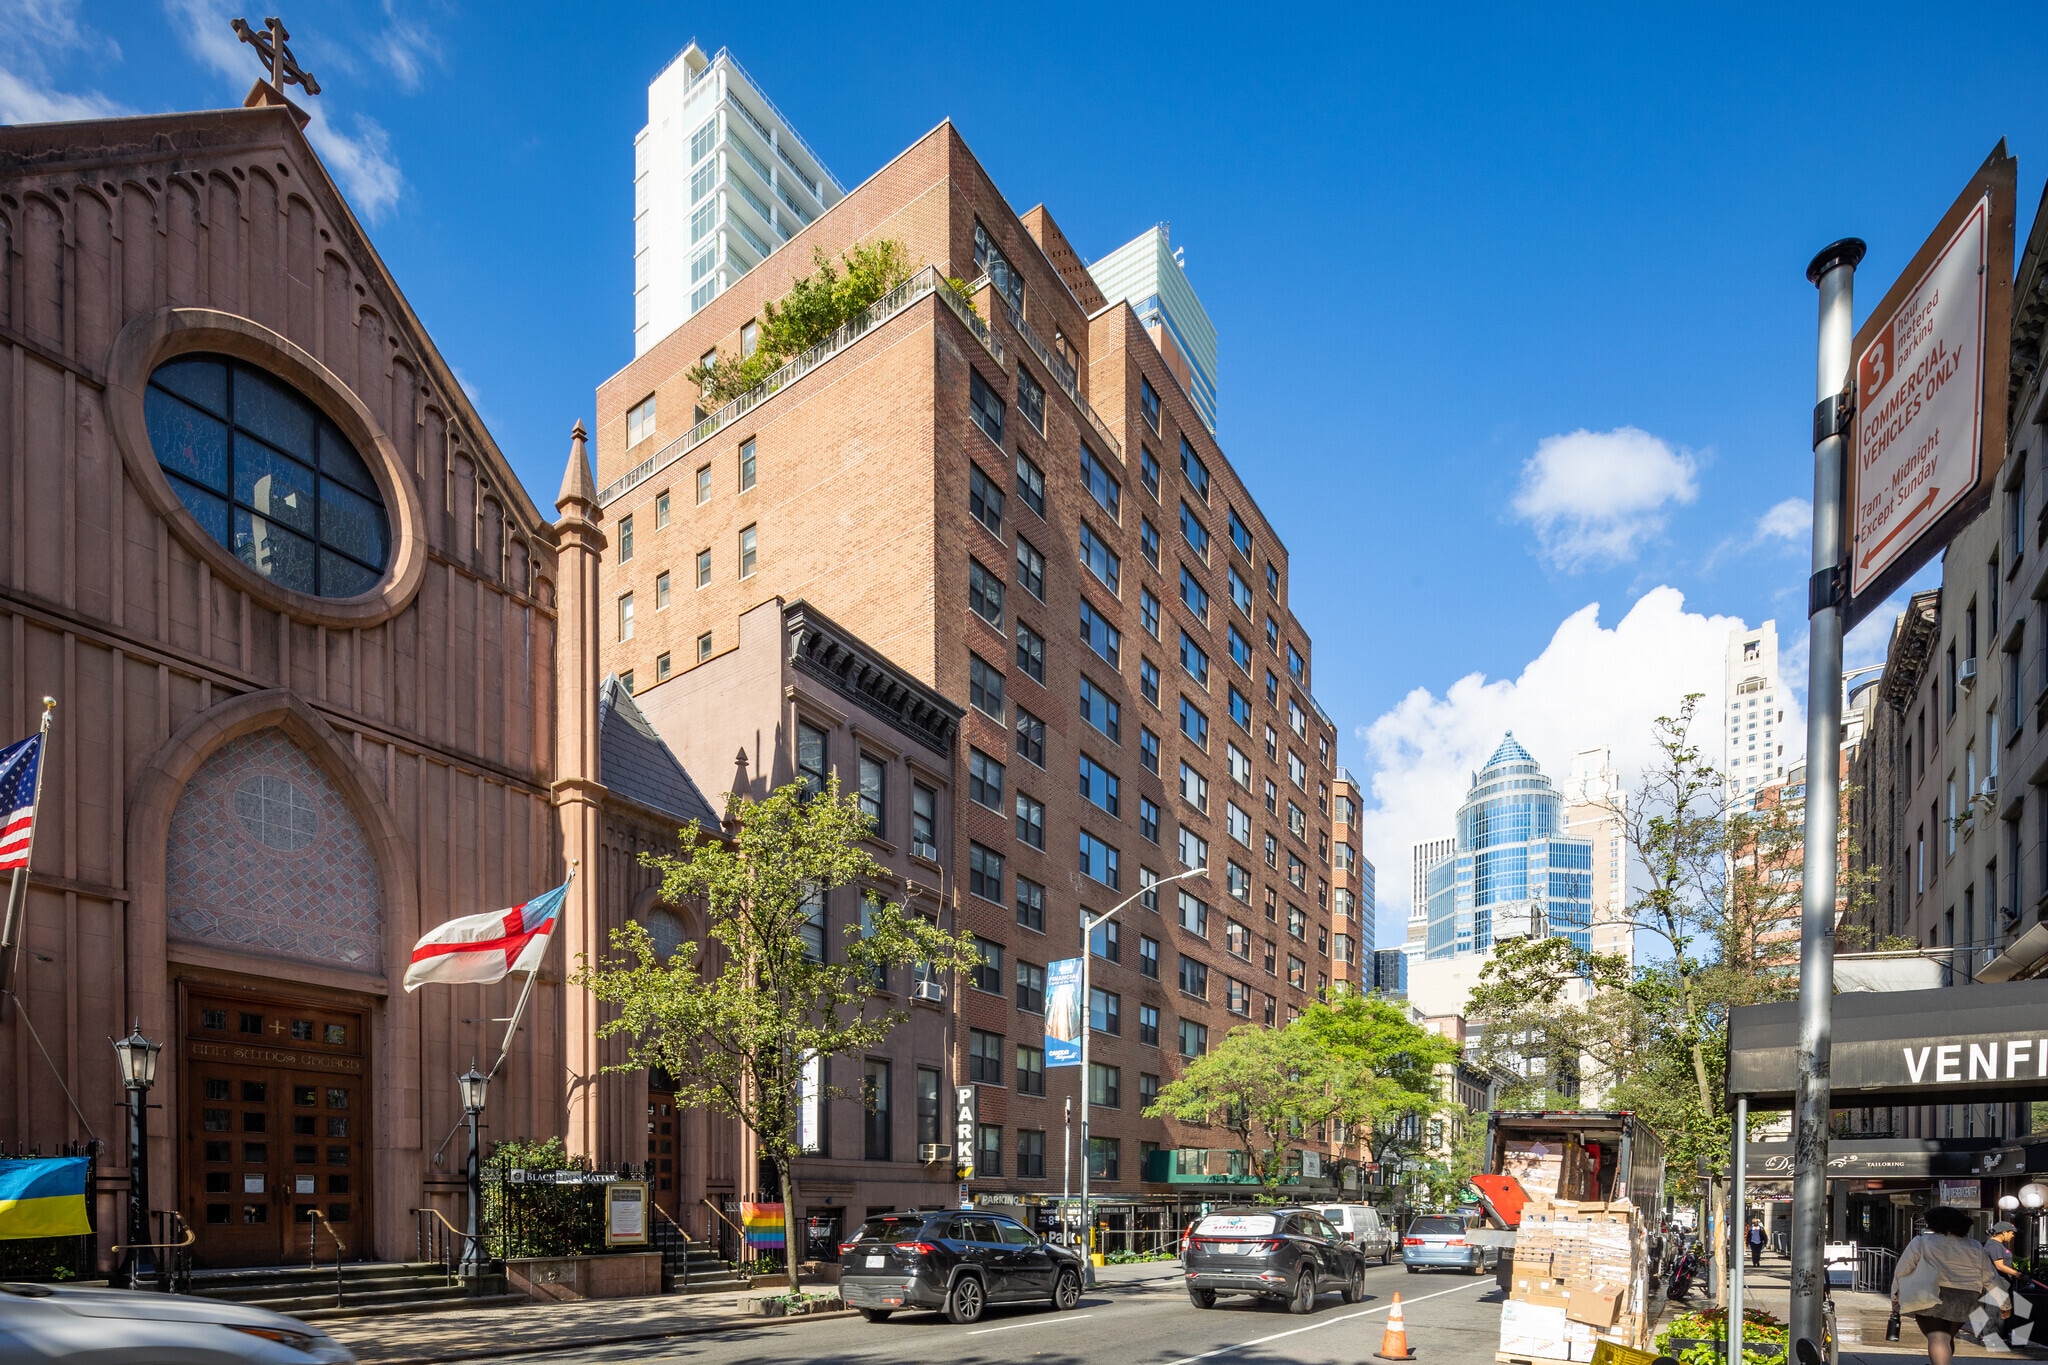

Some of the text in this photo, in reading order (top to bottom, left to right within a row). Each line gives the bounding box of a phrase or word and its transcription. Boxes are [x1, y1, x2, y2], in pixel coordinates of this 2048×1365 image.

[1897, 297, 1920, 333] hour
[1897, 288, 1939, 351] metered
[1897, 318, 1934, 373] parking
[1863, 338, 1947, 447] COMMERCIAL
[1867, 342, 1886, 396] 3
[1863, 344, 1963, 472] VEHICLES ONLY
[1861, 492, 1882, 523] 7am
[1891, 426, 1940, 492] Midnight
[1861, 454, 1939, 544] Except Sunday
[958, 1088, 973, 1157] PARK
[526, 1172, 555, 1182] BLACK
[583, 1173, 617, 1182] MATTER
[981, 1195, 1019, 1205] PARKING
